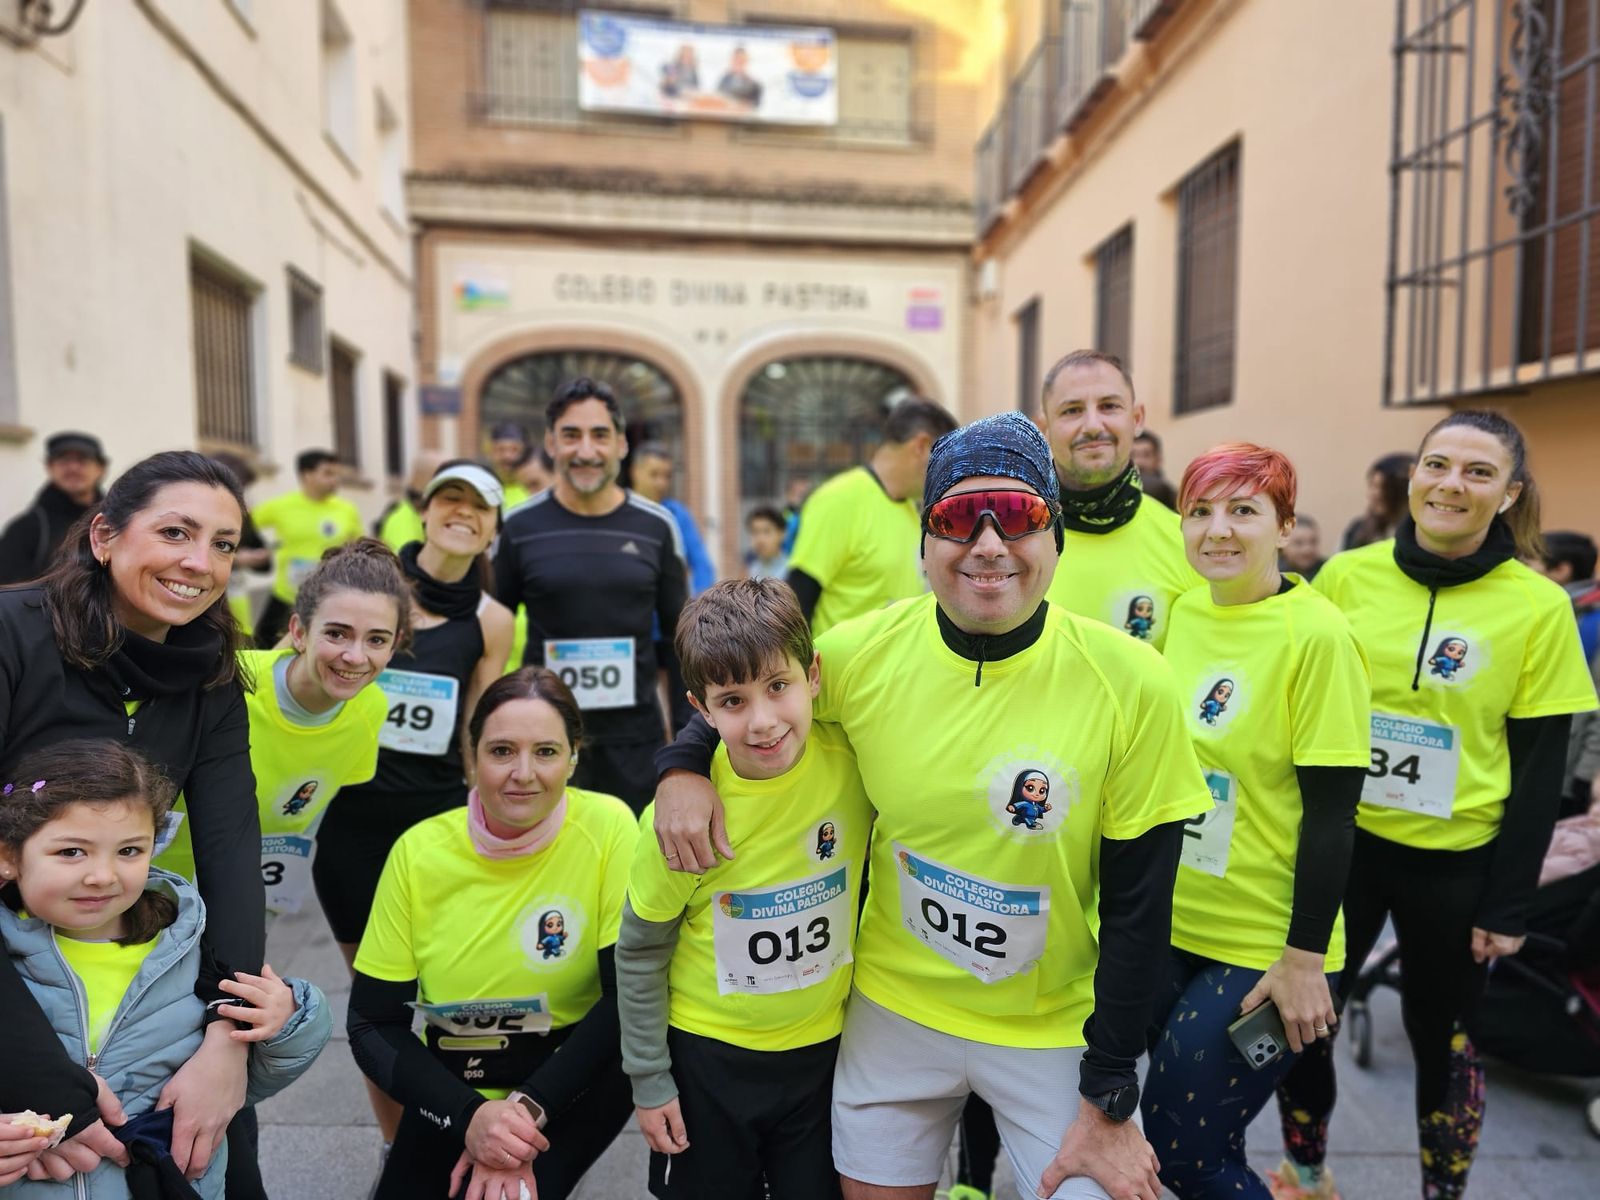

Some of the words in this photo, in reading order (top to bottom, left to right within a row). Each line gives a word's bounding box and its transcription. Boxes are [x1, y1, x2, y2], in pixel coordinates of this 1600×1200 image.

[560, 665, 621, 691] 050
[386, 702, 434, 731] 49
[1373, 719, 1424, 735] COLEGIO
[1391, 731, 1445, 748] PASTORA
[1366, 747, 1421, 785] 34
[262, 845, 303, 855] ASTORA
[752, 904, 796, 918] DIVINA
[797, 884, 842, 910] PASTORA
[774, 880, 826, 903] COLEGIO
[923, 875, 966, 901] DIVINA
[967, 893, 1030, 915] PASTORA
[945, 874, 1005, 901] COLEGIO
[748, 916, 831, 965] 013
[921, 898, 1007, 959] 012
[462, 1002, 513, 1011] COLEGIO
